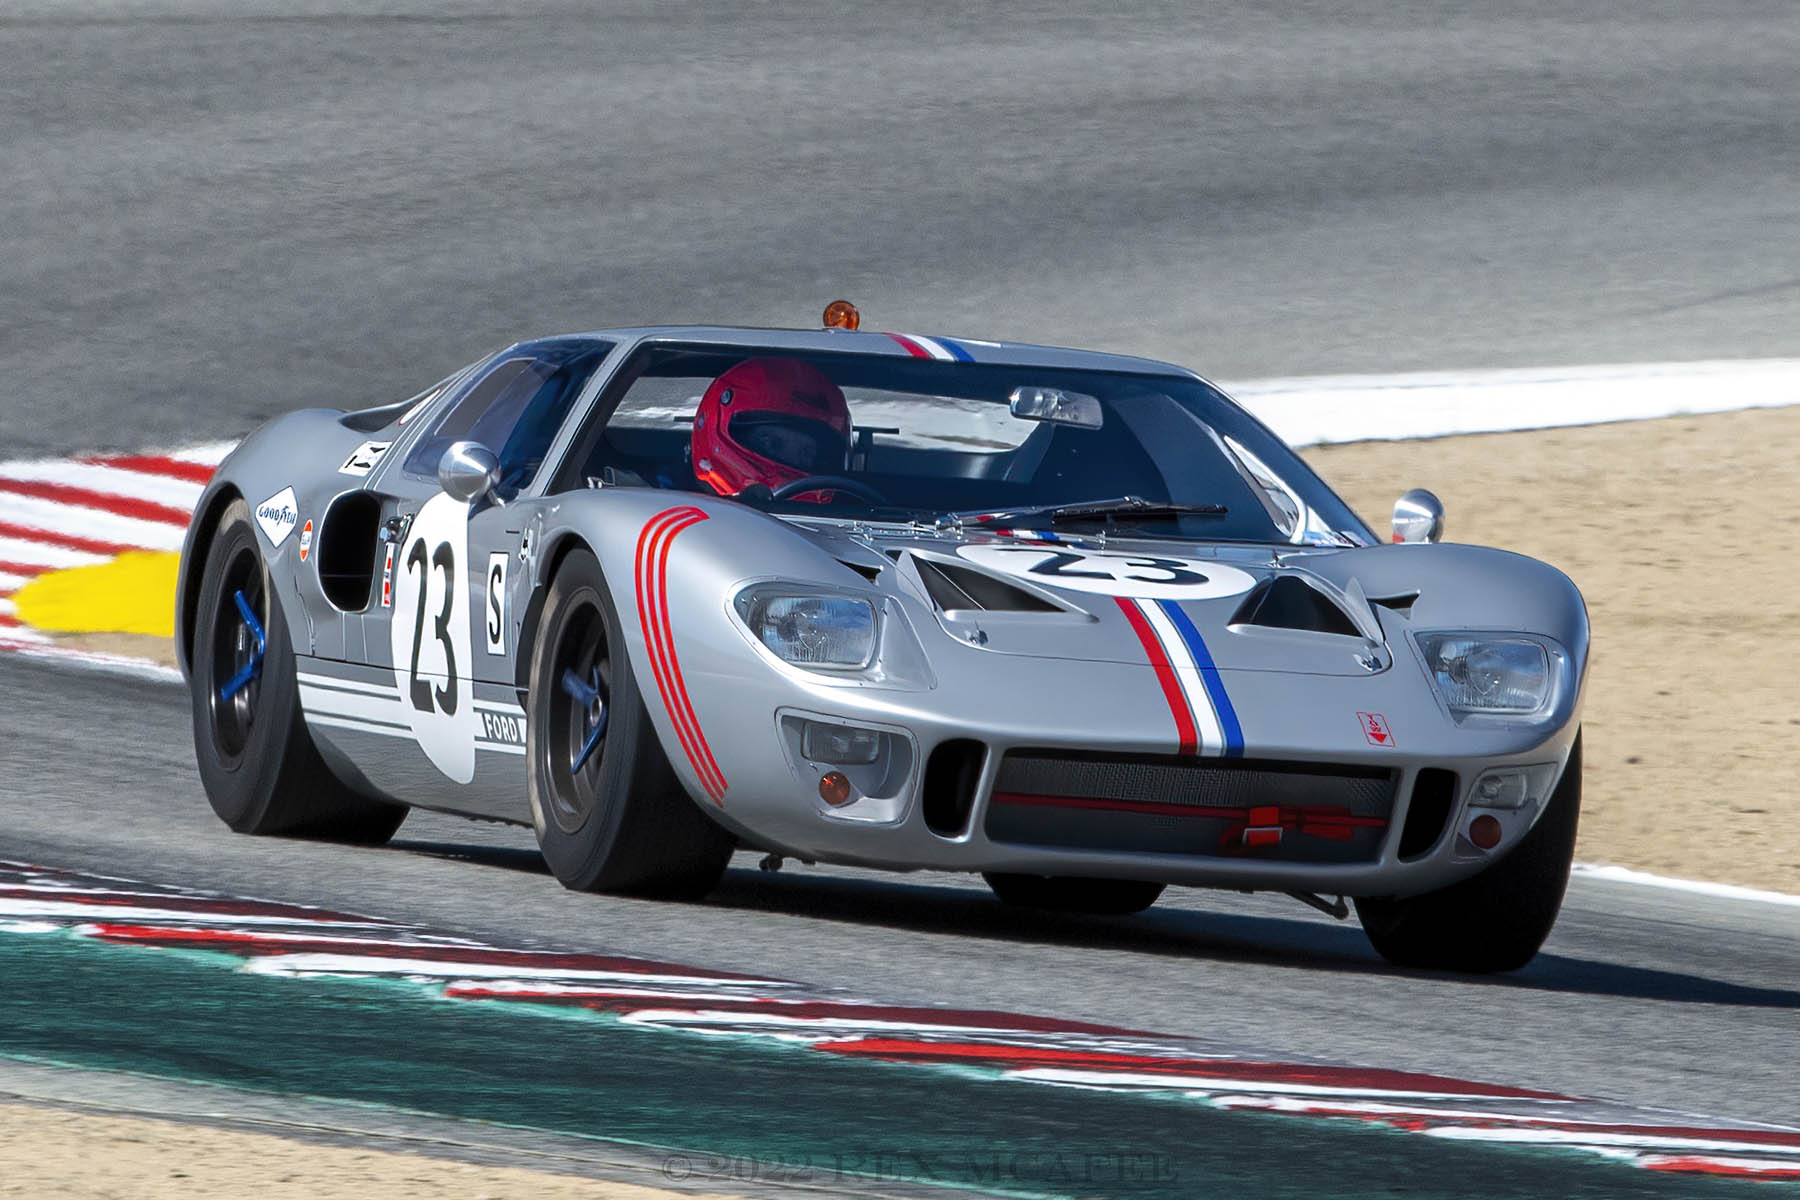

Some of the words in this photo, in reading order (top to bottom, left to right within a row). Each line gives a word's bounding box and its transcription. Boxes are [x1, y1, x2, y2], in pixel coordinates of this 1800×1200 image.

[993, 548, 1210, 585] 23
[407, 537, 458, 717] 23
[489, 564, 502, 645] S
[484, 713, 518, 742] FORD
